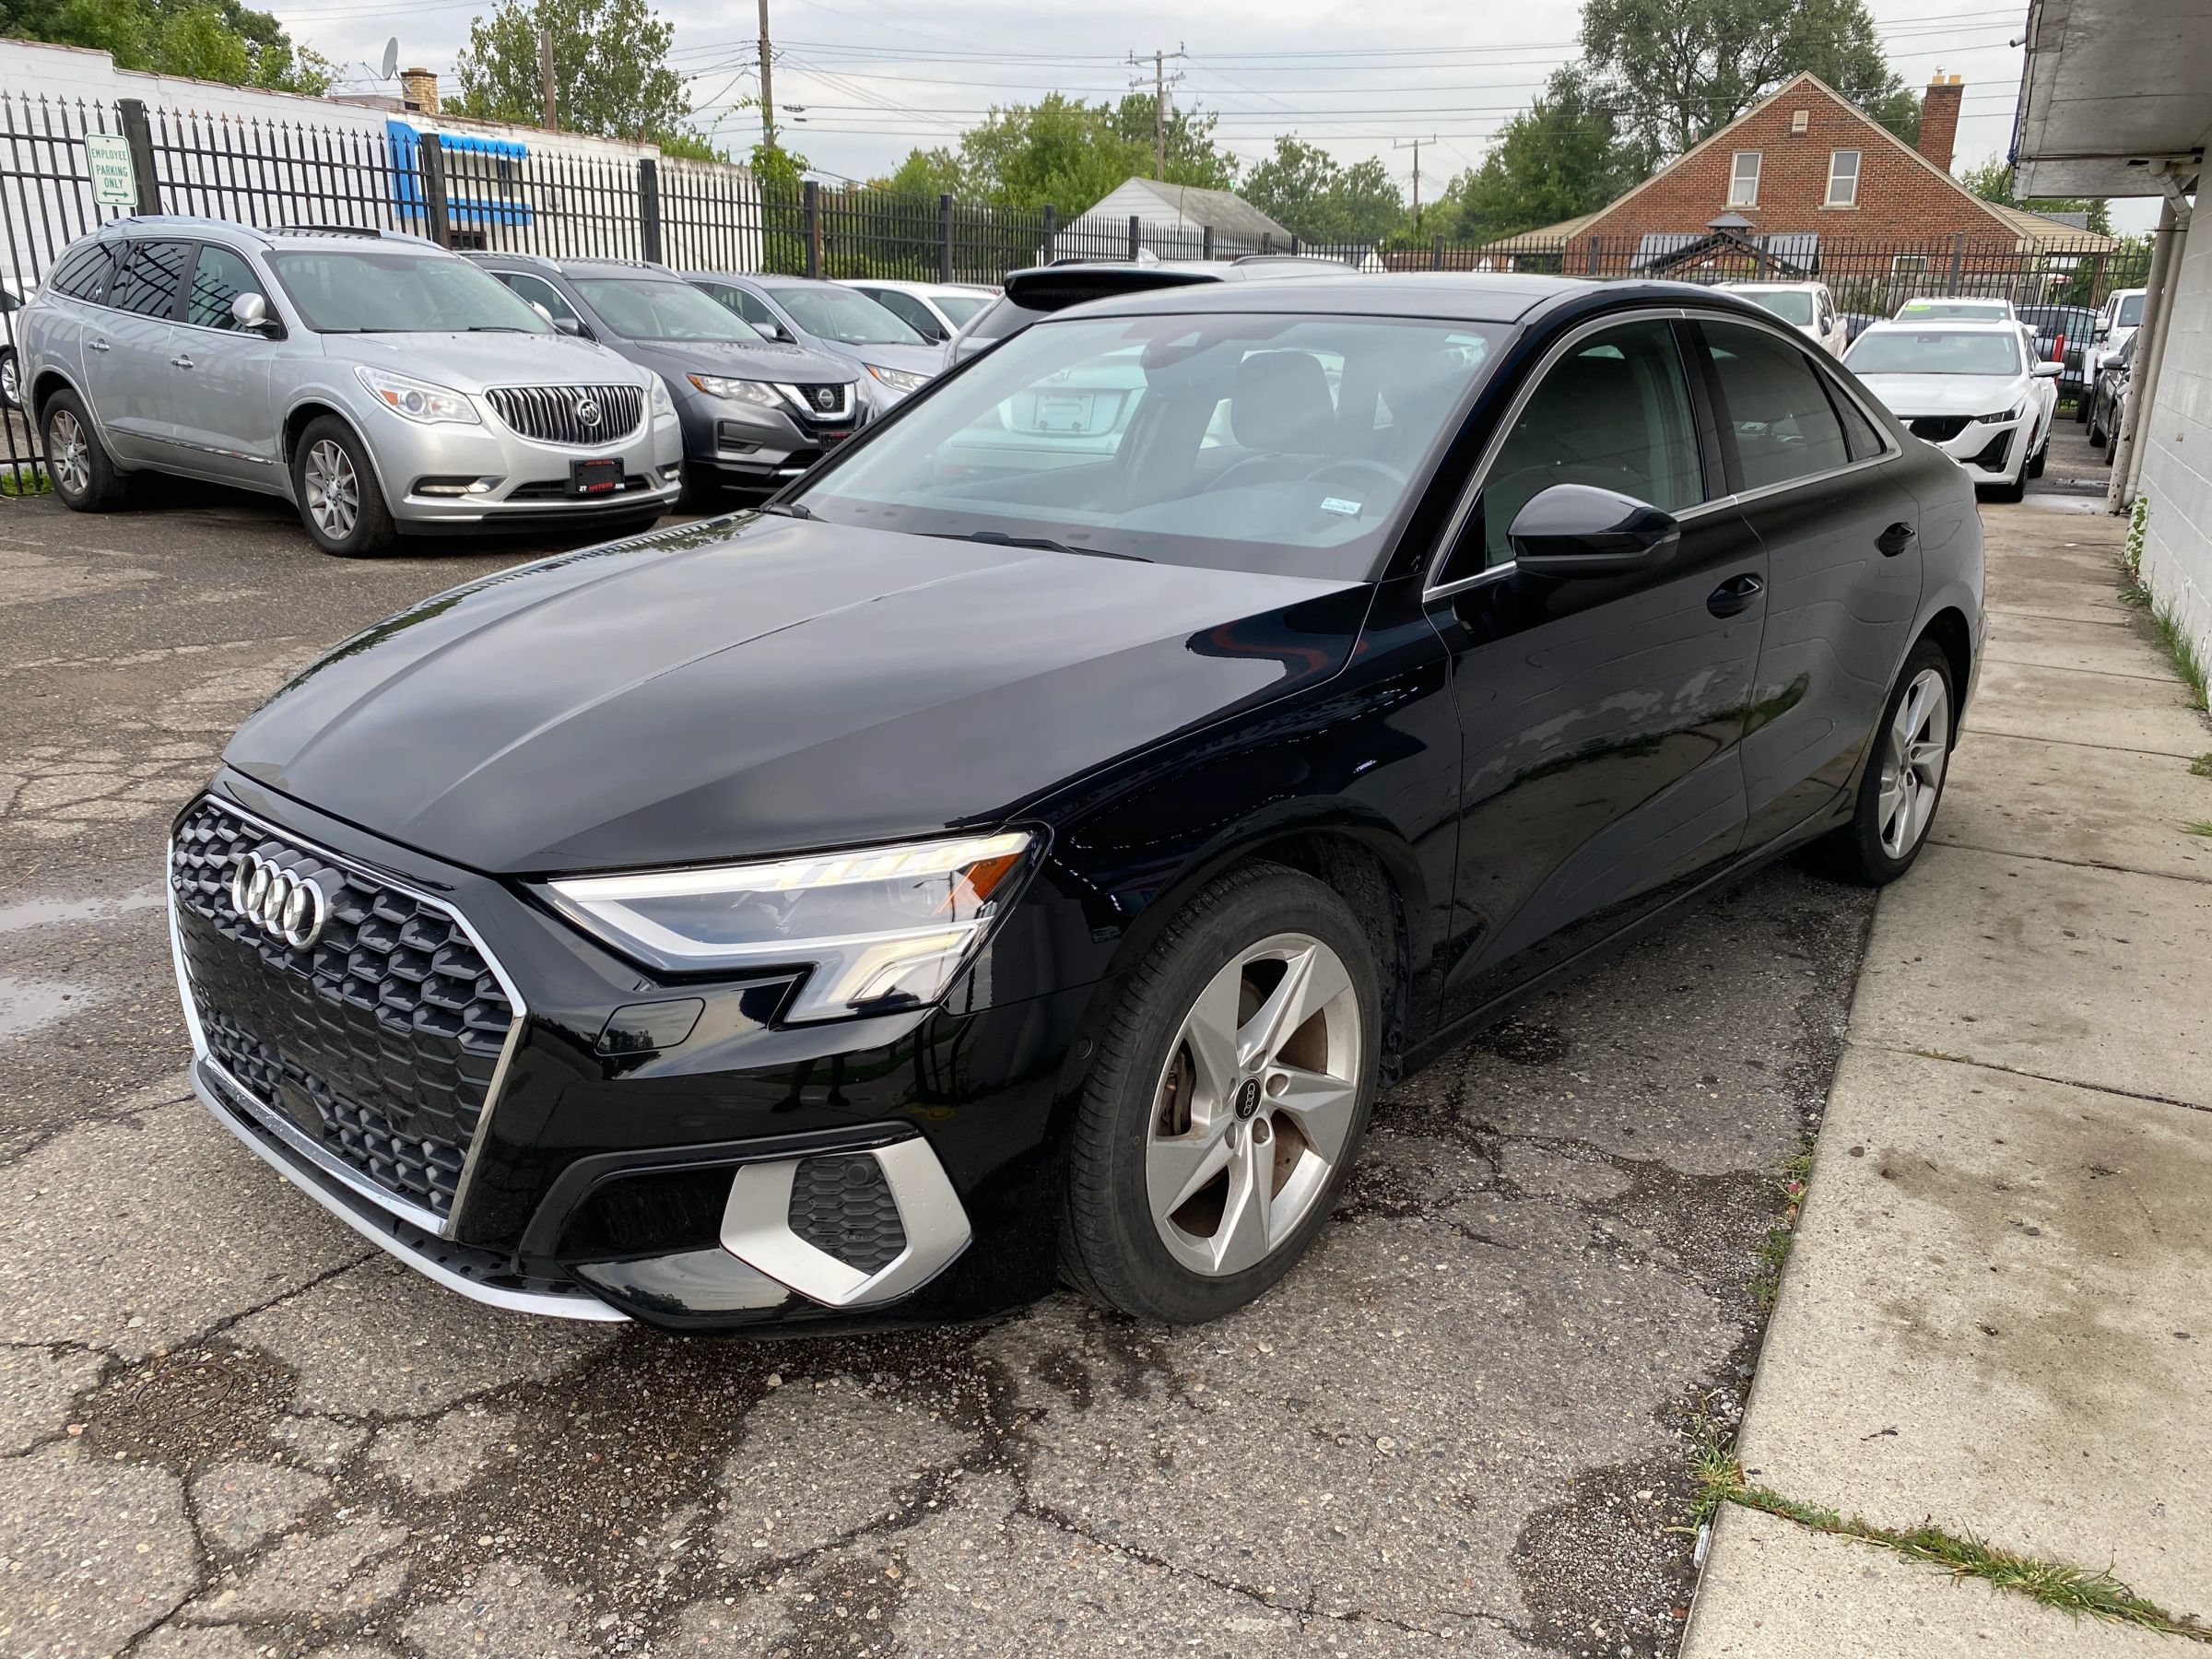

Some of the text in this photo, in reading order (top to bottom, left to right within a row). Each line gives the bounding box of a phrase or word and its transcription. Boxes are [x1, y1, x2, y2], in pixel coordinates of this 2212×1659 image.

[91, 148, 127, 160] EMPLOYEE
[96, 165, 128, 177] PARKING
[104, 177, 123, 189] ONLY
